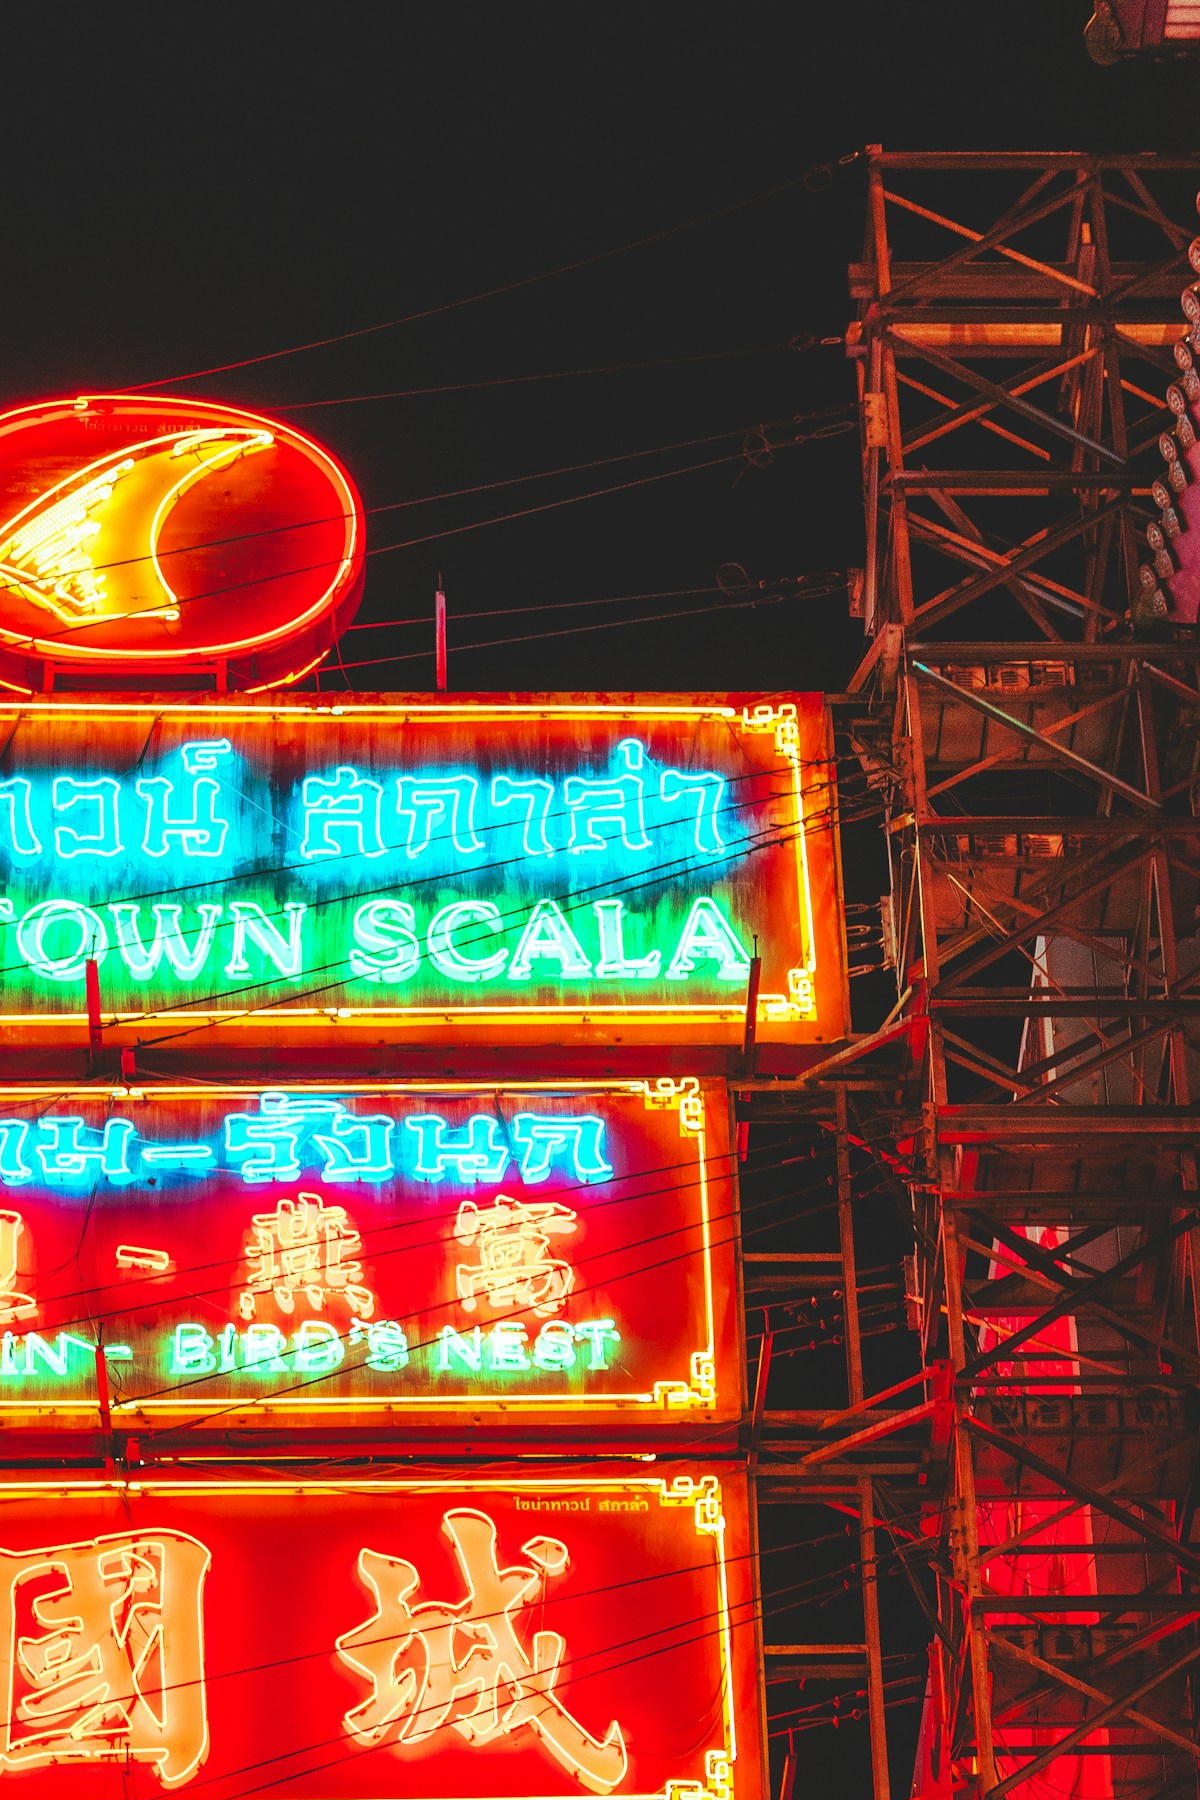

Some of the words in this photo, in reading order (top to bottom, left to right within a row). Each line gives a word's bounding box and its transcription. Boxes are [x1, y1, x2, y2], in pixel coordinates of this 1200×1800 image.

[301, 738, 728, 858] สกาล่า
[348, 898, 756, 982] SCALA
[169, 1318, 409, 1375] BIRD'S
[436, 1319, 621, 1374] NEST
[513, 1496, 590, 1511] ไชน่าทาวน์
[598, 1494, 649, 1512] สกาล่า
